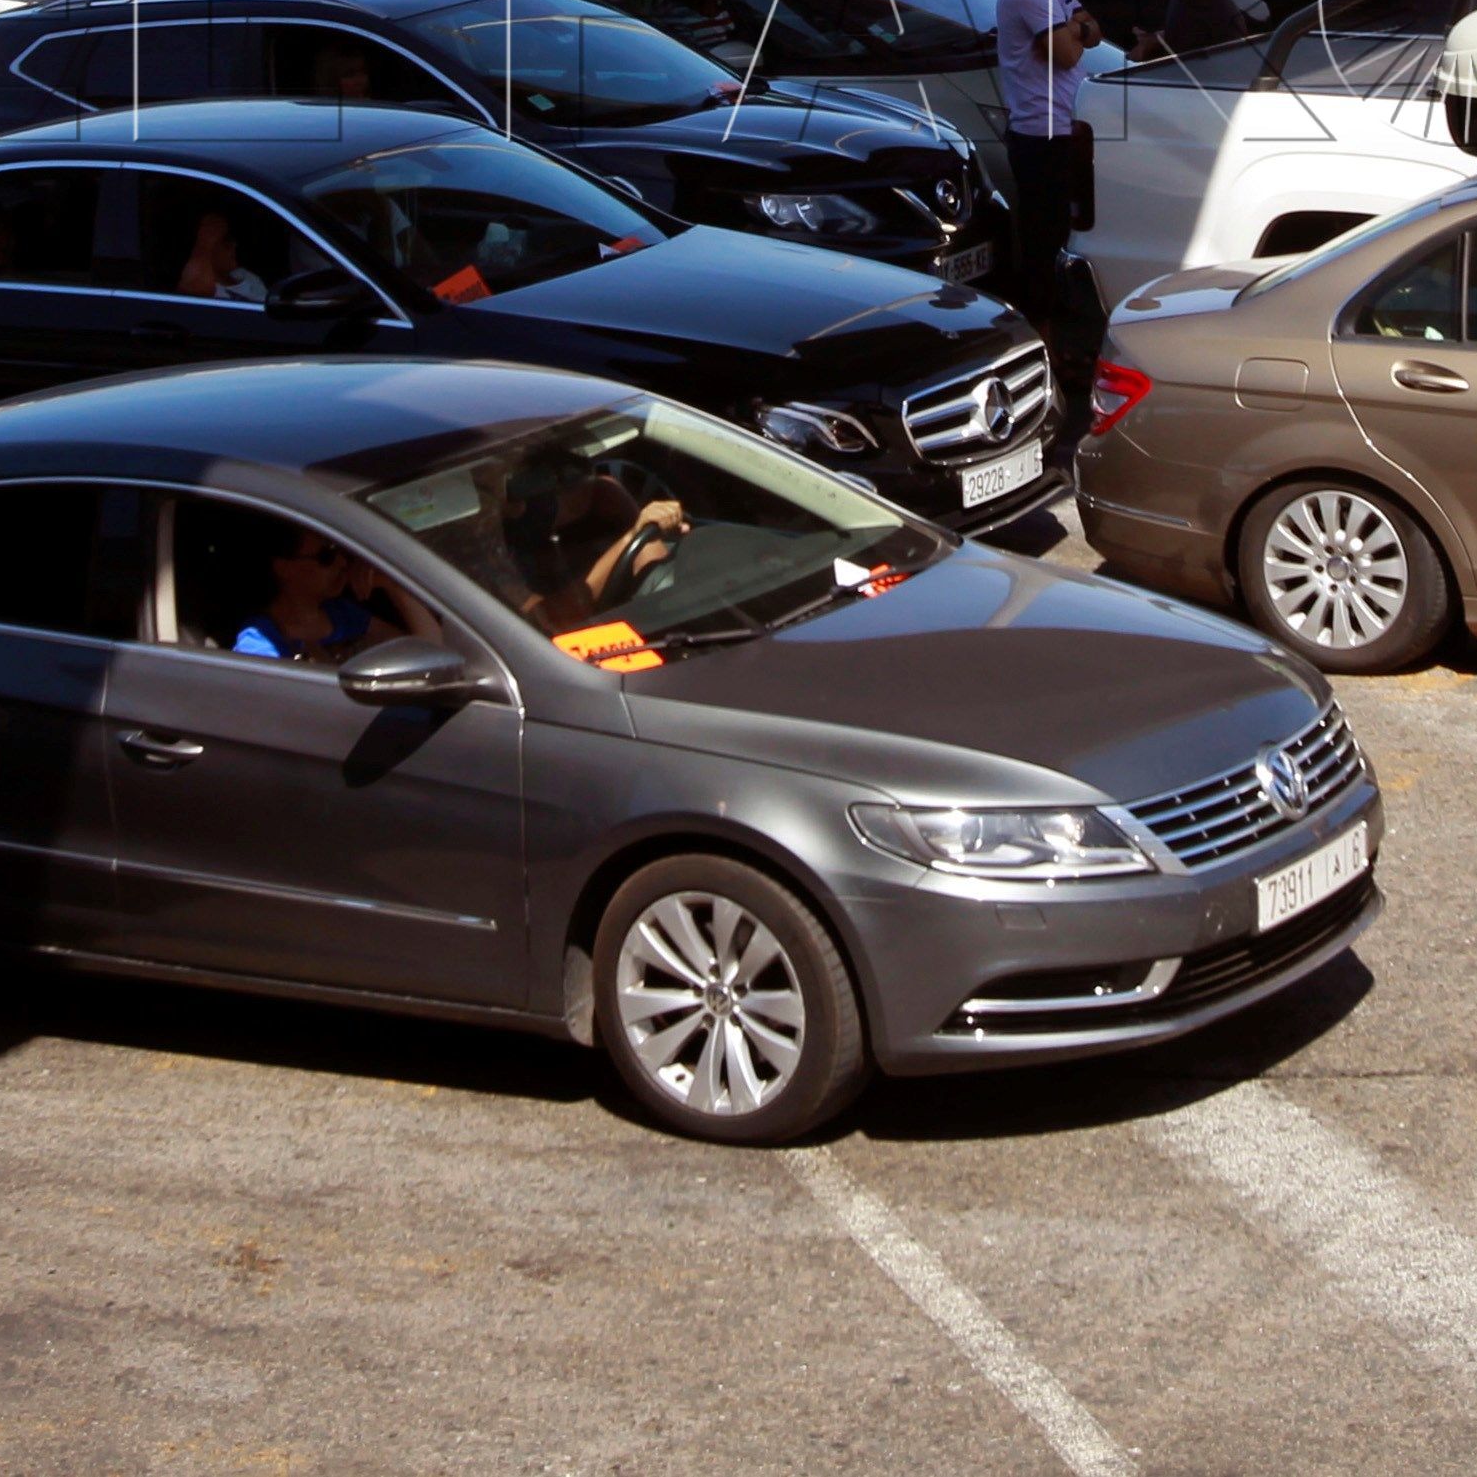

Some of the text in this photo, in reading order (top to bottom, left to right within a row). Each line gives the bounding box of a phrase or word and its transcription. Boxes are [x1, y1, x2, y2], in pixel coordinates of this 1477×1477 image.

[969, 466, 1004, 501] 29228
[1268, 860, 1314, 921] 73911
[1352, 830, 1360, 869] 6
